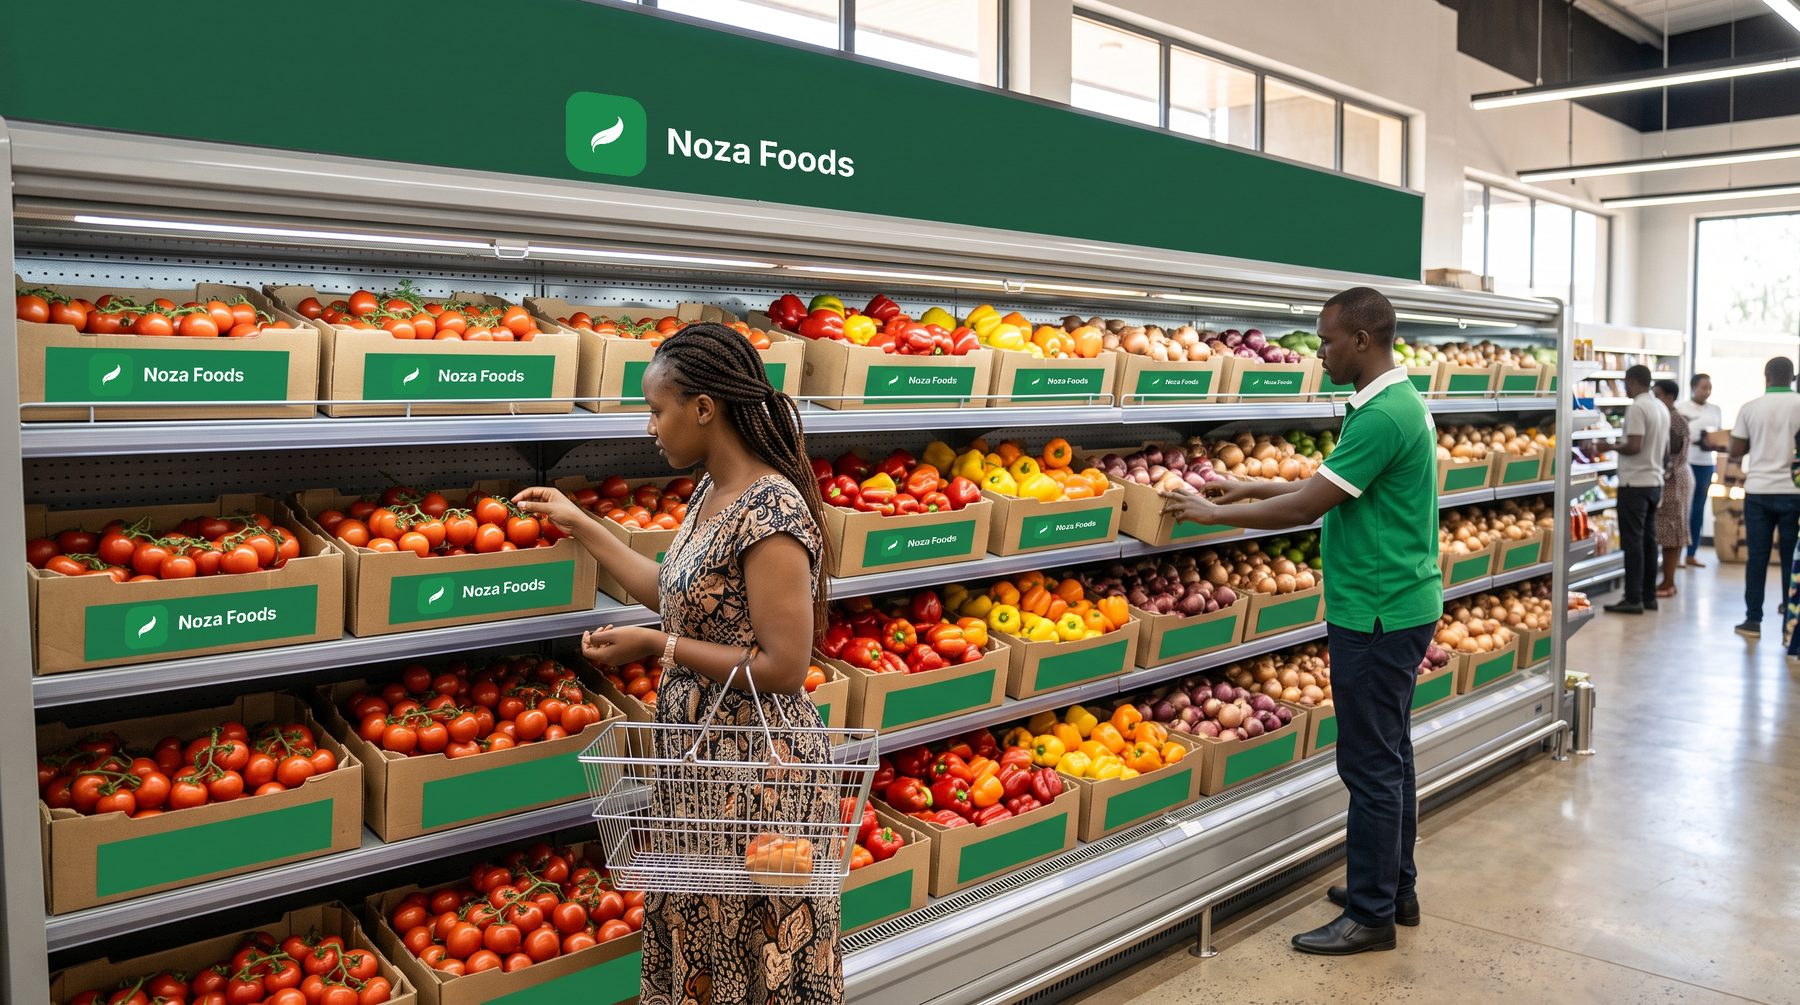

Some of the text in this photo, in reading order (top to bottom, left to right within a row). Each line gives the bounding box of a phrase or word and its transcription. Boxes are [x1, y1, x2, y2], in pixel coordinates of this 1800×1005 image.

[667, 127, 855, 179] Noza Foods
[143, 367, 245, 383] Noza Foods
[438, 368, 525, 384] Noza Foods
[908, 375, 958, 385] Noza Foods
[1047, 376, 1089, 385] Noza Foods
[1055, 519, 1097, 532] Noza Foods
[907, 534, 957, 548] Noza Foods
[462, 578, 546, 600] Noza Foods
[178, 606, 277, 632] Noza Foods
